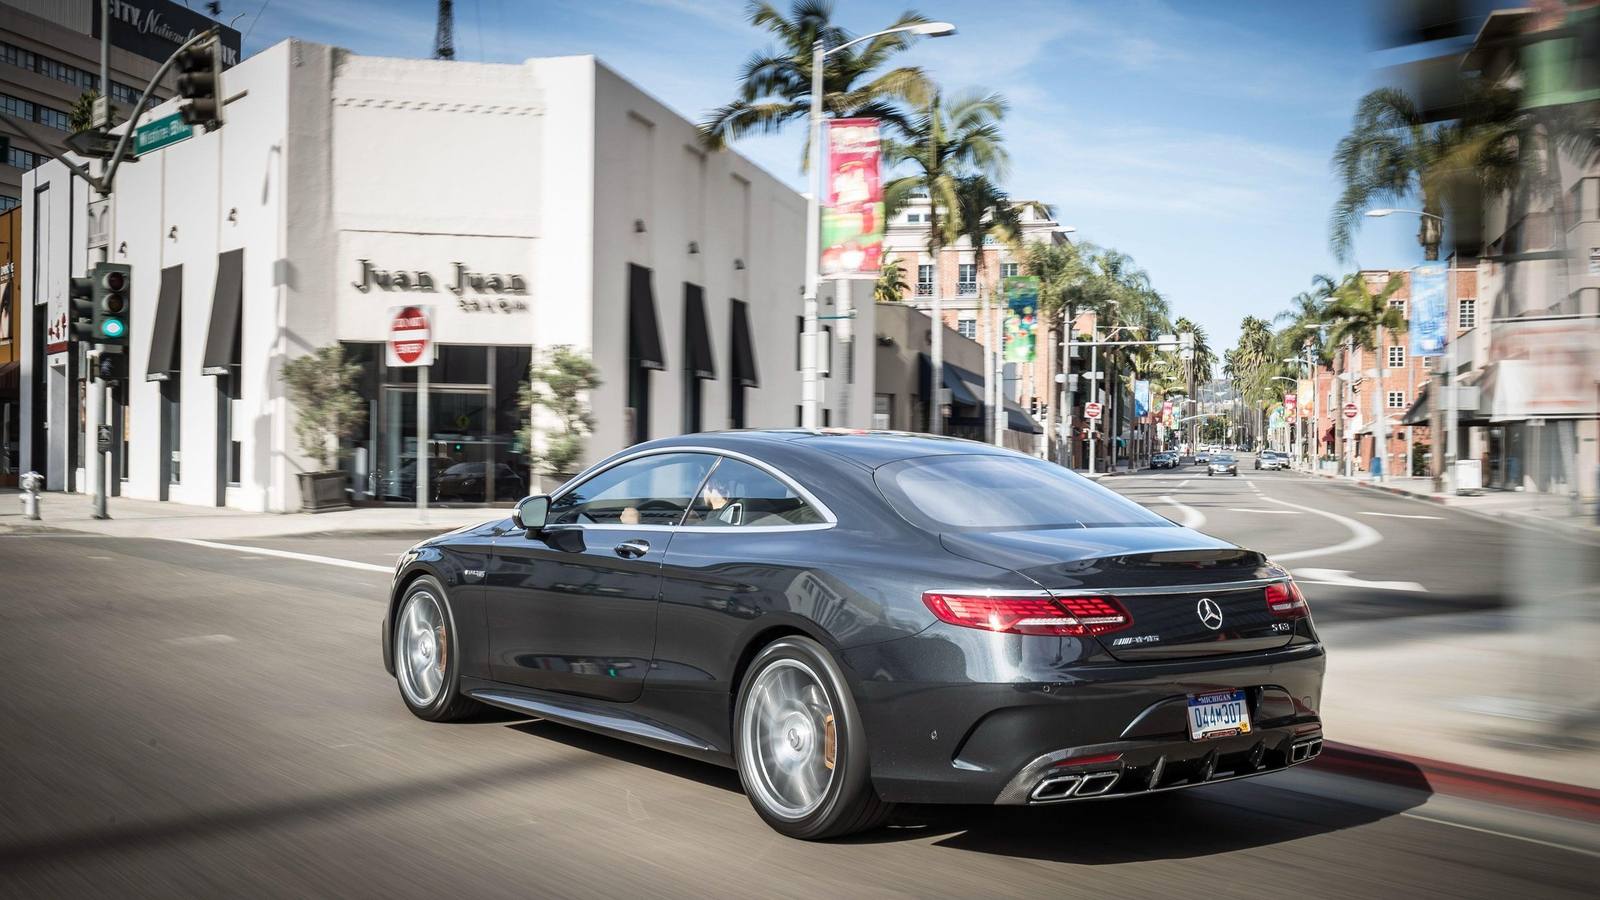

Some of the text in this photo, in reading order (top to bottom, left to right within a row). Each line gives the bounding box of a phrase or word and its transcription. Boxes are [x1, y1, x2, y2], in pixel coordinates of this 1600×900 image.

[352, 259, 528, 295] Juan Juan
[1200, 694, 1231, 704] MICHIGAN
[1194, 702, 1242, 729] 044M307
